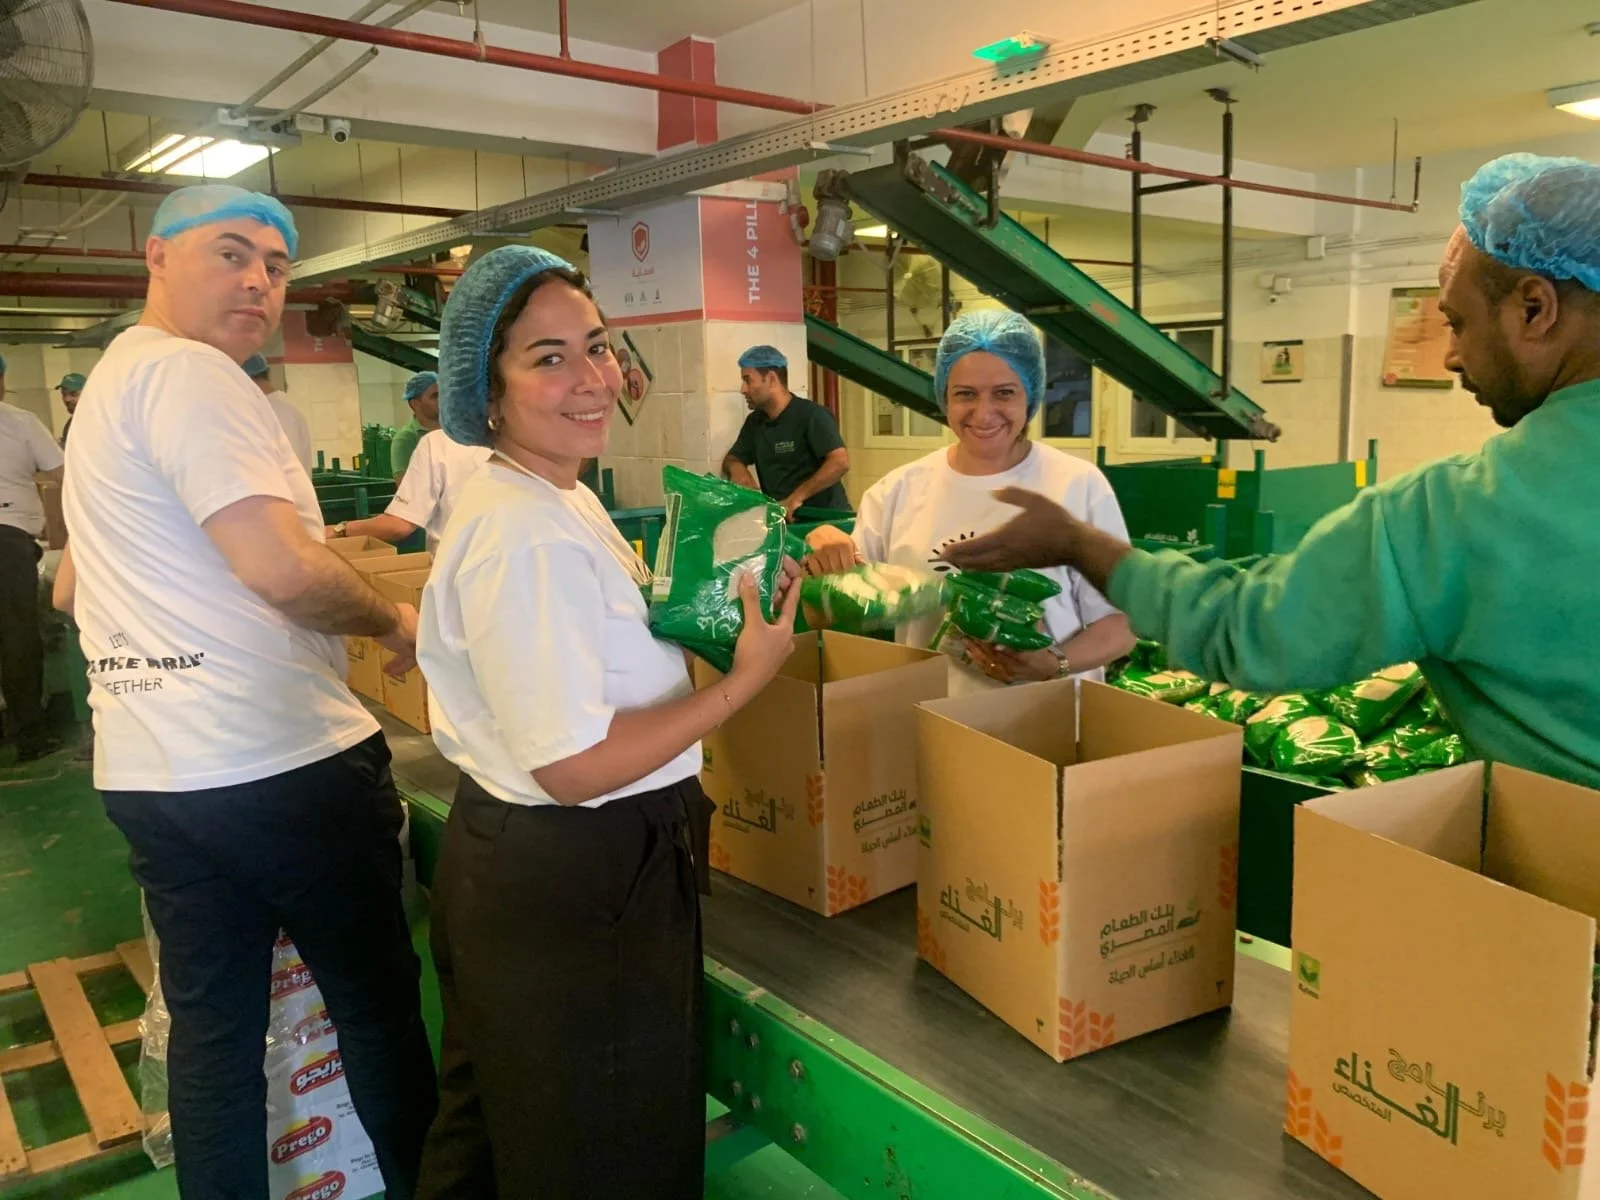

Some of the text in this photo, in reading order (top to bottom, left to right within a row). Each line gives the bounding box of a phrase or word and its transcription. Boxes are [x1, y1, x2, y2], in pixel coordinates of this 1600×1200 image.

[747, 246, 758, 259] 4
[748, 264, 760, 304] THE
[1099, 909, 1149, 940] الطعام
[271, 971, 313, 993] Preg
[1332, 1081, 1393, 1124] المتخصص
[1334, 1051, 1460, 1147] الغذاء
[1387, 1048, 1507, 1138] برنامج
[276, 1126, 327, 1159] Prego
